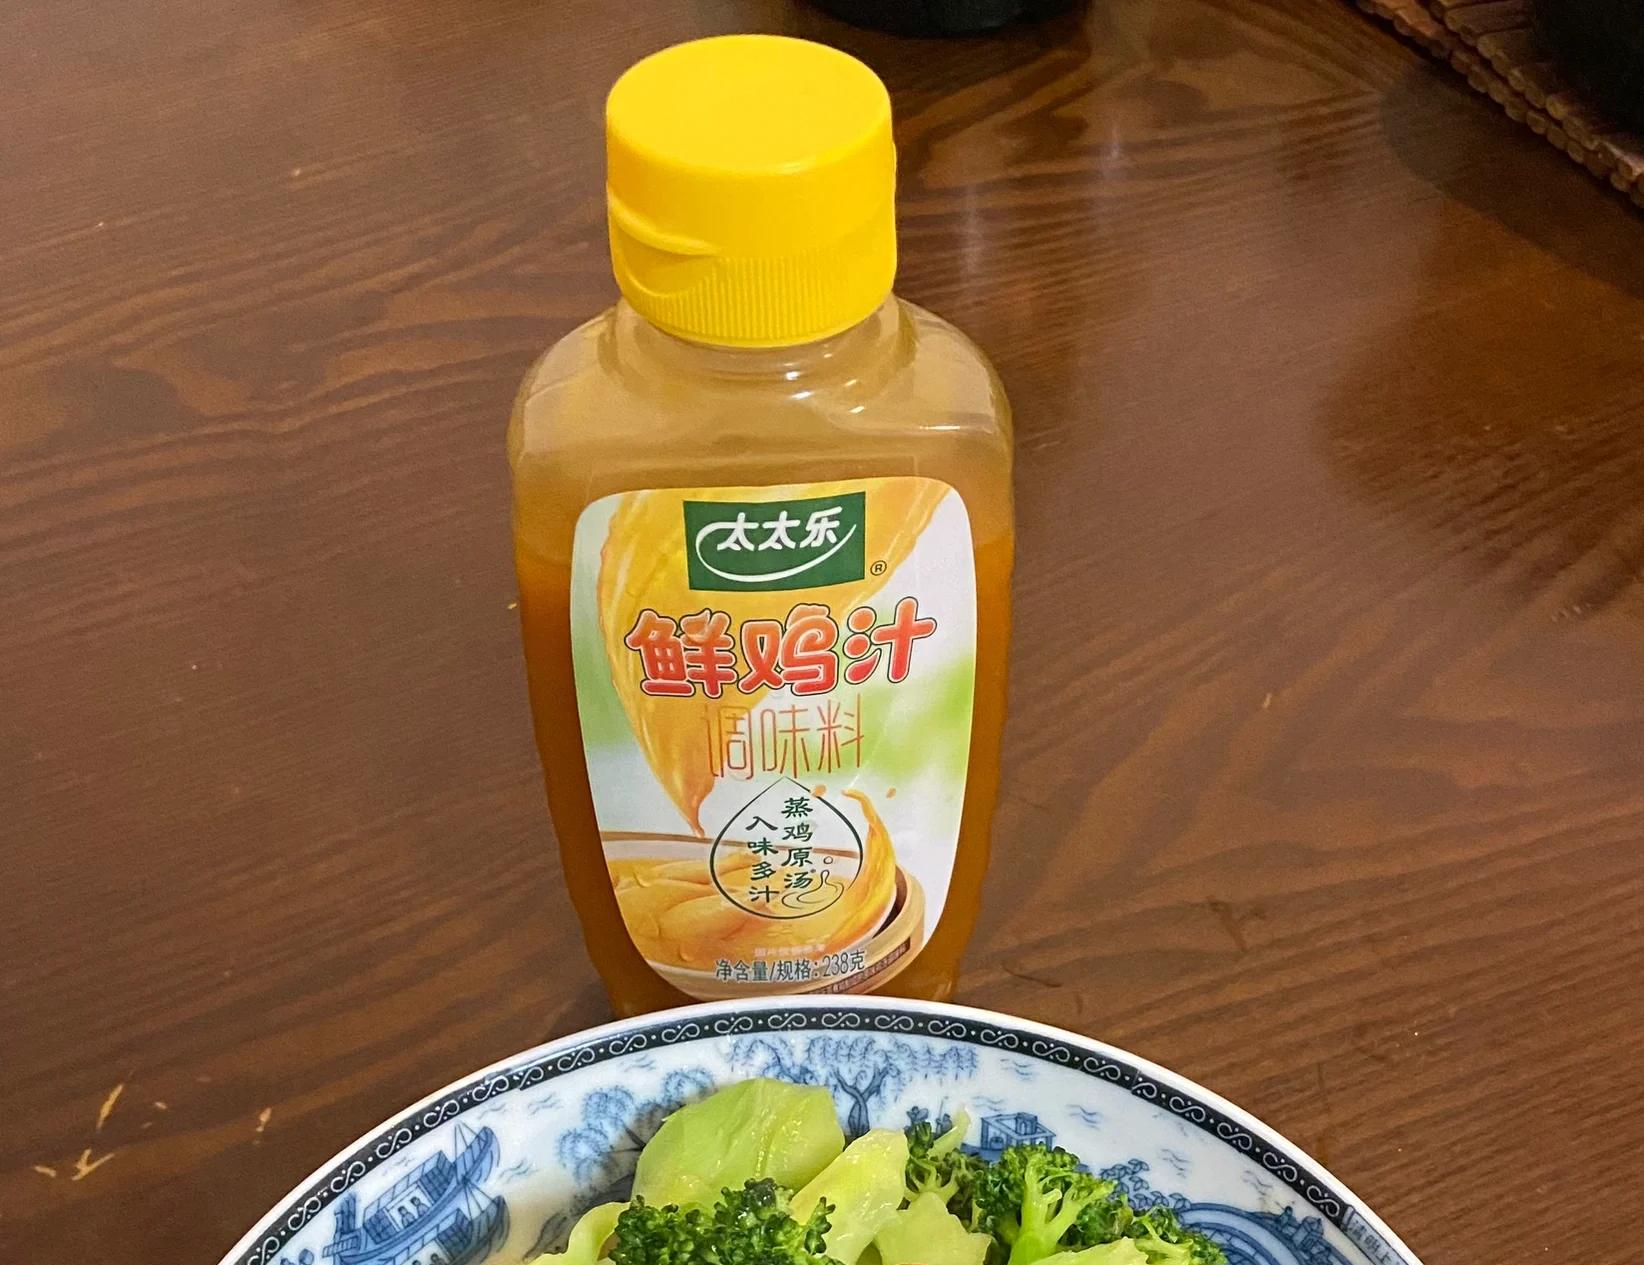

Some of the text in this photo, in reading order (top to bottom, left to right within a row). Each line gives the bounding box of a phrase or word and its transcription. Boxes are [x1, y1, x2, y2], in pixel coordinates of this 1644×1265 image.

[716, 506, 844, 552] 太太乐
[625, 597, 938, 699] 鲜鸡汁
[702, 693, 865, 781] 调味料
[745, 816, 780, 903] 入味多汁
[781, 796, 814, 890] 蒸鸡原汤
